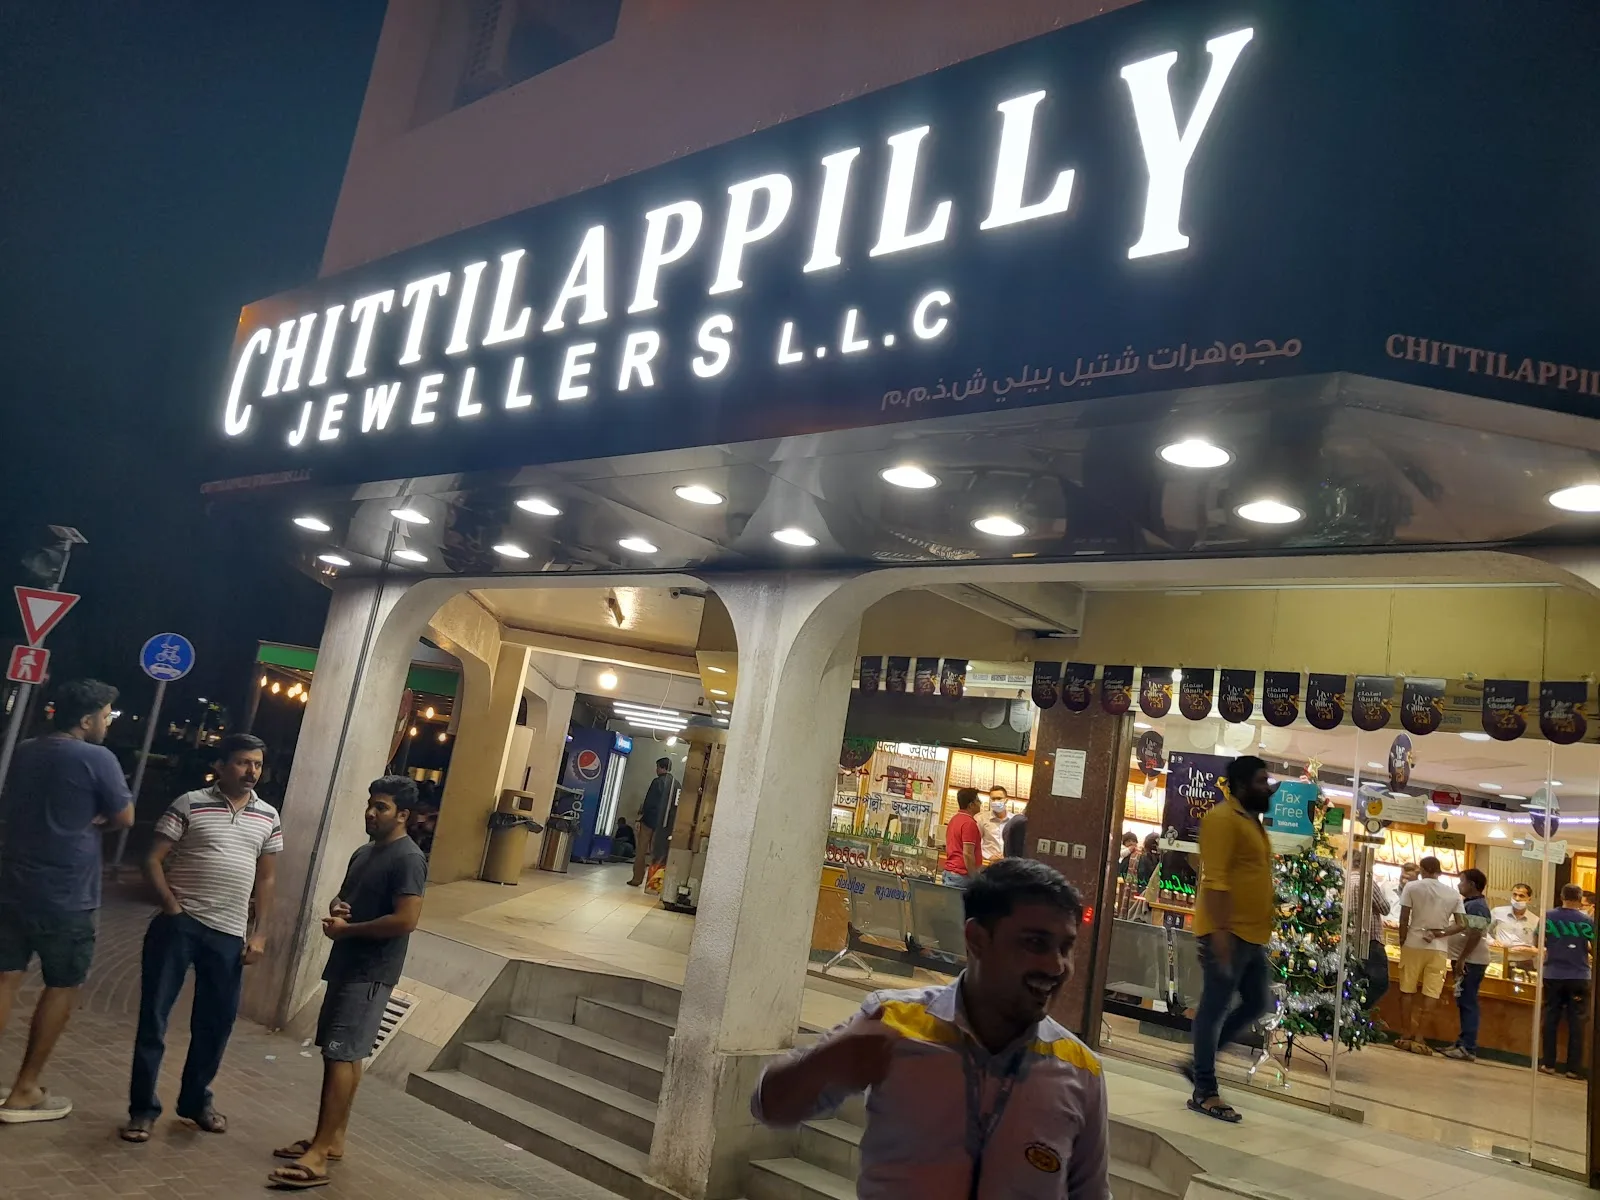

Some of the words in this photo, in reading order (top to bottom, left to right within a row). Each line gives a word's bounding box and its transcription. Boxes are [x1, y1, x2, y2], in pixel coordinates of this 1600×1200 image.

[223, 27, 1254, 437] CHITTILAPPILLY
[1147, 336, 1303, 373] مجوهرات
[287, 312, 735, 448] JEWELLERS
[777, 290, 952, 365] L.L.C
[1188, 766, 1214, 782] Live
[1178, 783, 1216, 799] Glitter
[1279, 789, 1301, 804] Tax
[1274, 803, 1304, 819] Free
